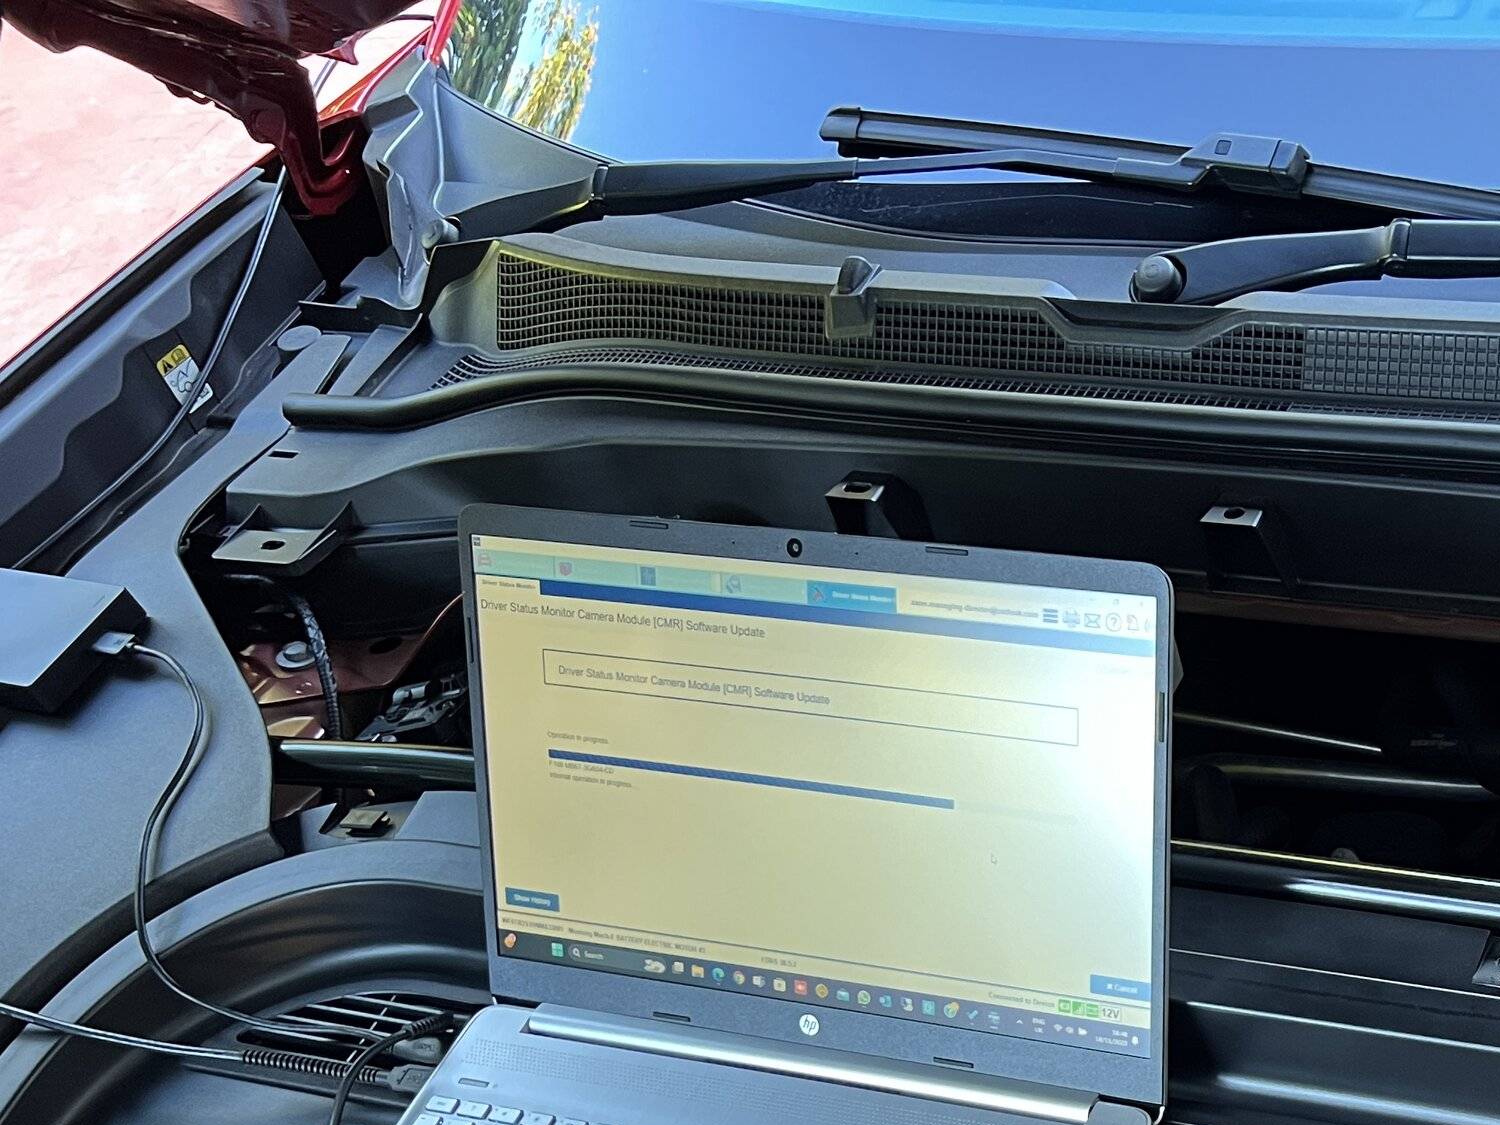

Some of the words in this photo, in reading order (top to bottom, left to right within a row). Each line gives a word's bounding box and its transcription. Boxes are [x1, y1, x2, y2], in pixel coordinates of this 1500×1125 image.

[480, 599, 508, 611] Driver
[510, 602, 539, 615] Status
[540, 606, 576, 619] Monitor
[577, 609, 614, 623] Camera
[616, 612, 651, 627] Module
[653, 616, 684, 632] [CMR]
[686, 619, 728, 635] Software
[730, 623, 766, 639] Update
[558, 664, 584, 677] Driver
[585, 668, 614, 680] Status
[616, 671, 648, 684] Monitor
[651, 675, 686, 689] Camera
[688, 679, 721, 693] Module
[722, 683, 752, 698] [CMR]
[754, 686, 795, 701] Software
[796, 691, 831, 705] Update
[801, 1015, 818, 1034] hp
[1101, 1007, 1121, 1020] 12V
